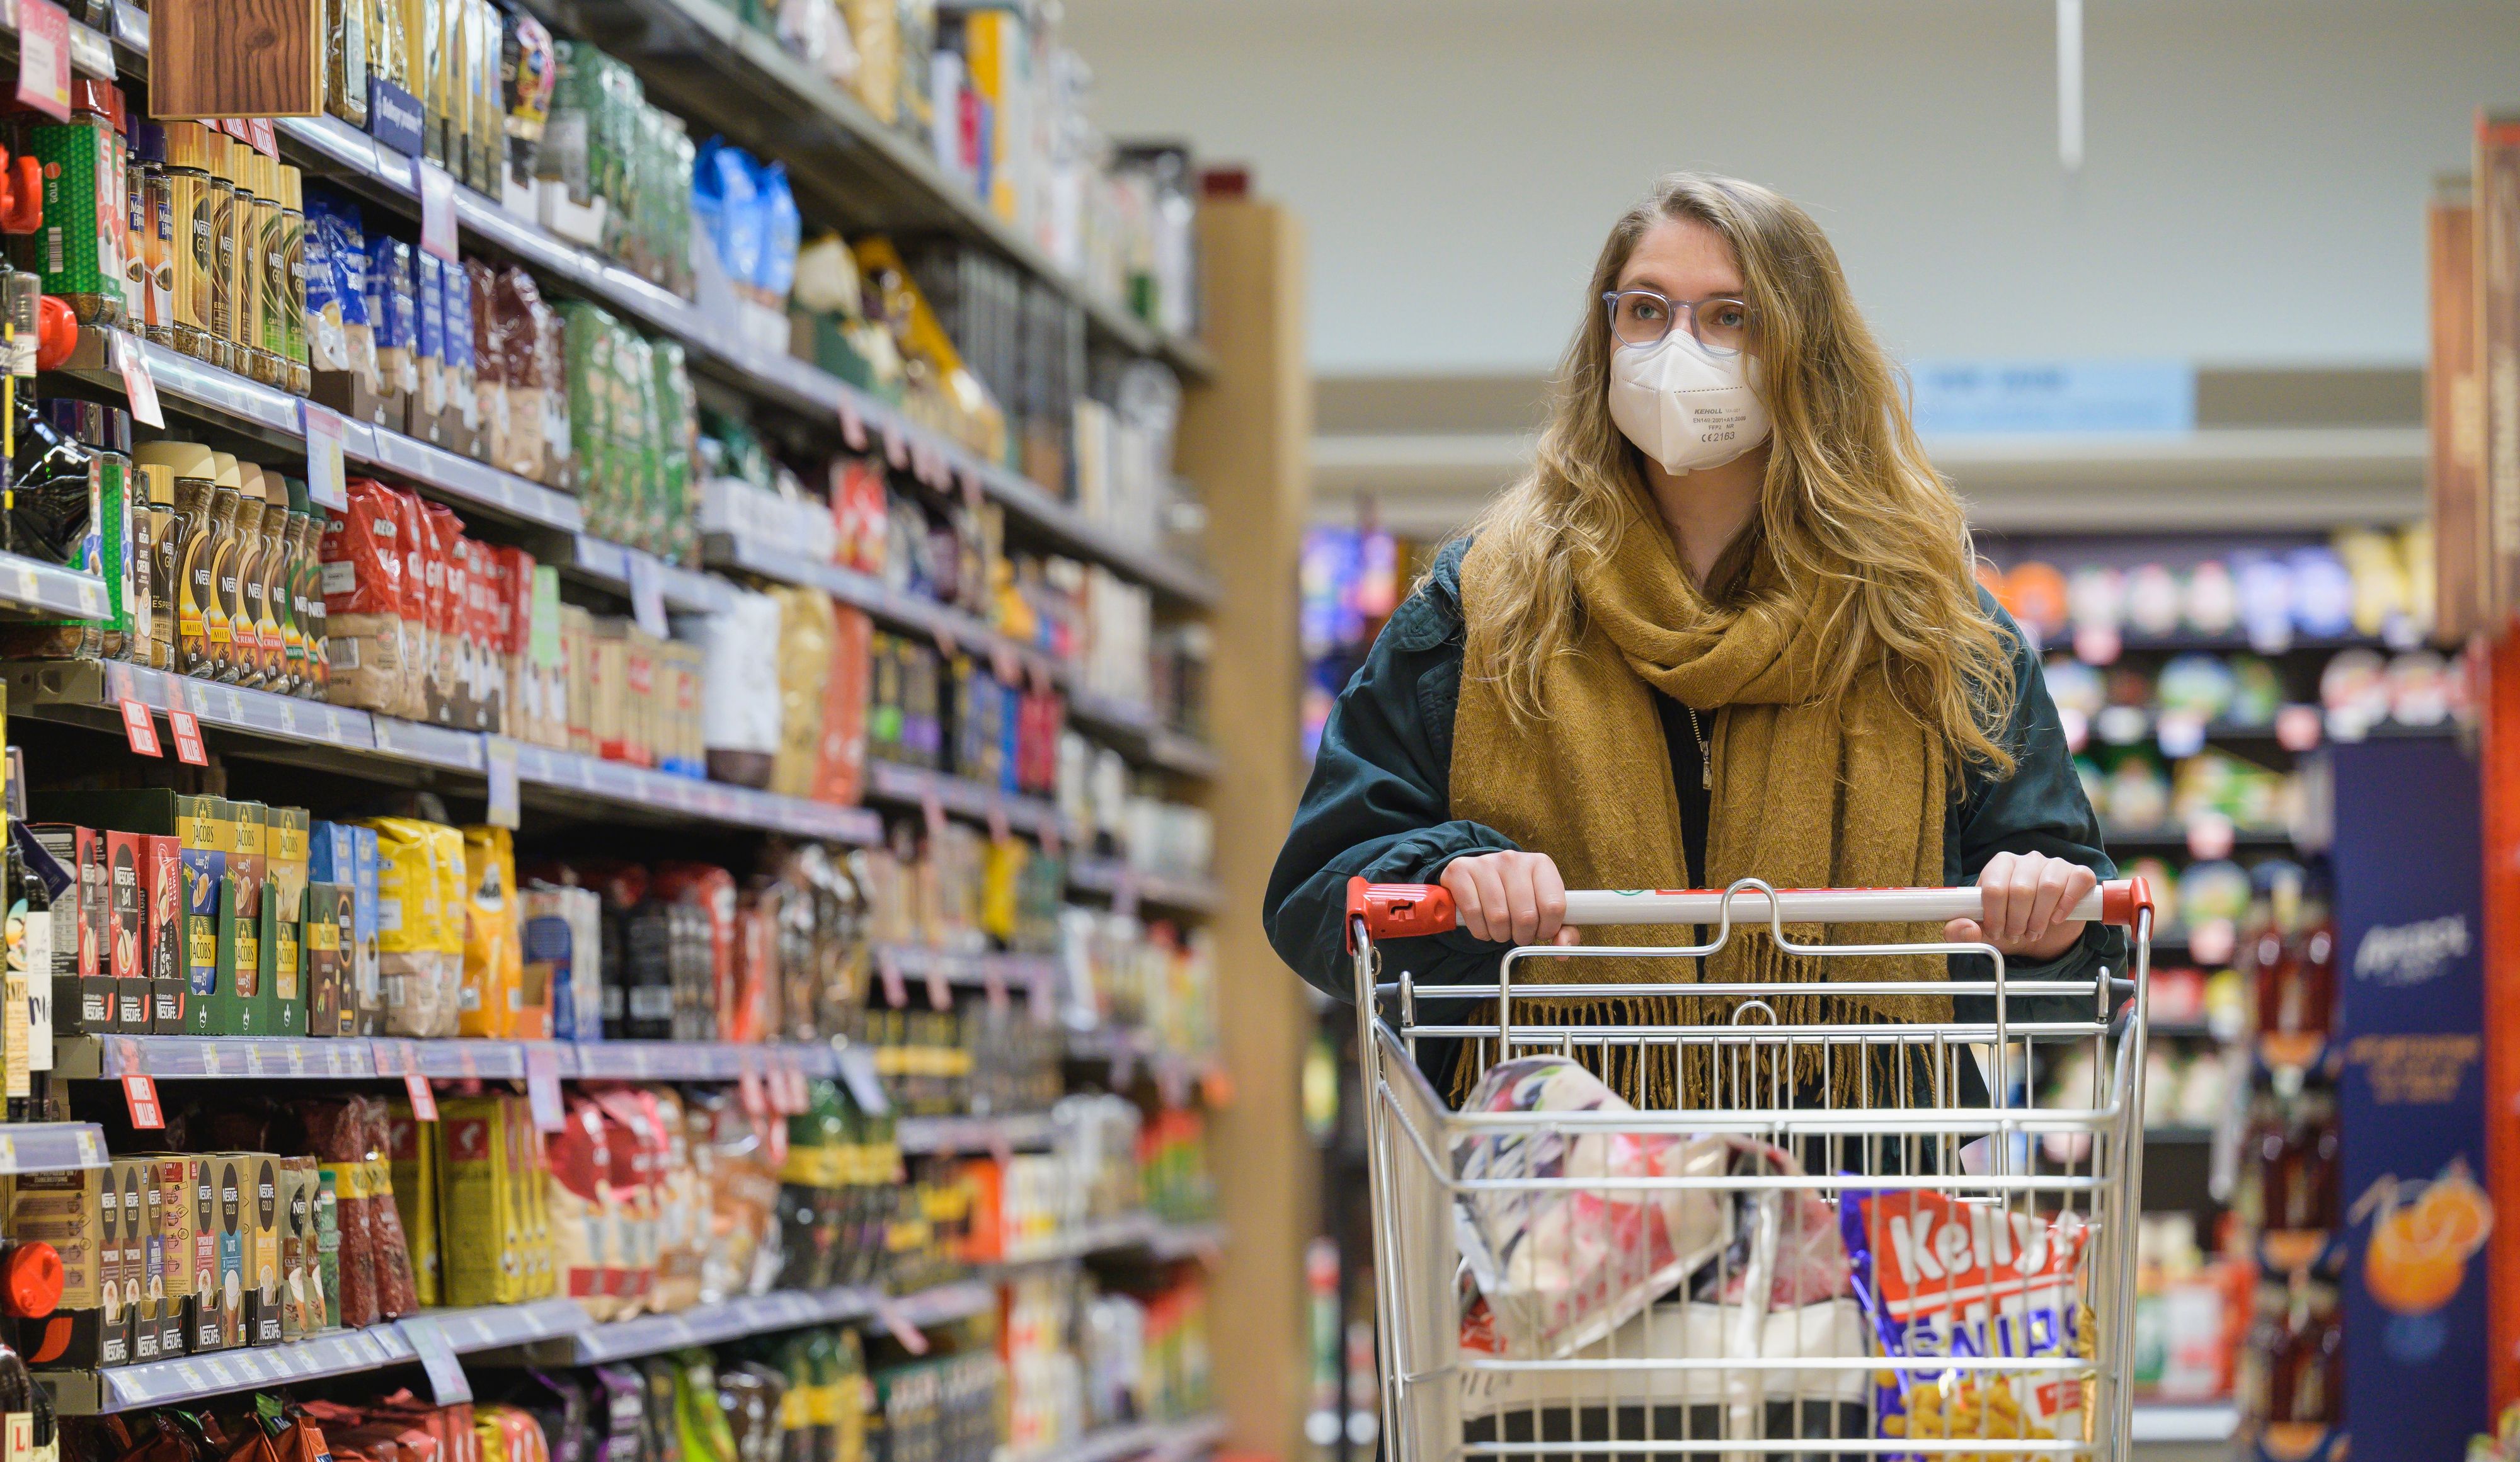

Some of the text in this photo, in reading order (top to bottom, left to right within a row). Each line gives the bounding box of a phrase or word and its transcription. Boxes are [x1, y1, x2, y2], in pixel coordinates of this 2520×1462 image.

[49, 182, 58, 203] GOLD
[1713, 431, 1735, 442] 2163
[192, 825, 214, 844] JACOBS
[235, 829, 255, 848] JACOBS
[280, 835, 297, 853] JACOBS
[190, 942, 211, 962] JACOBS
[235, 945, 254, 963] JACOBS
[201, 1202, 210, 1213] GOLD
[226, 1204, 236, 1215] GOLD
[261, 1200, 272, 1211] GOLD
[105, 1209, 115, 1222] GOLD
[127, 1209, 137, 1221] GOLD
[151, 1207, 159, 1218] GOLD
